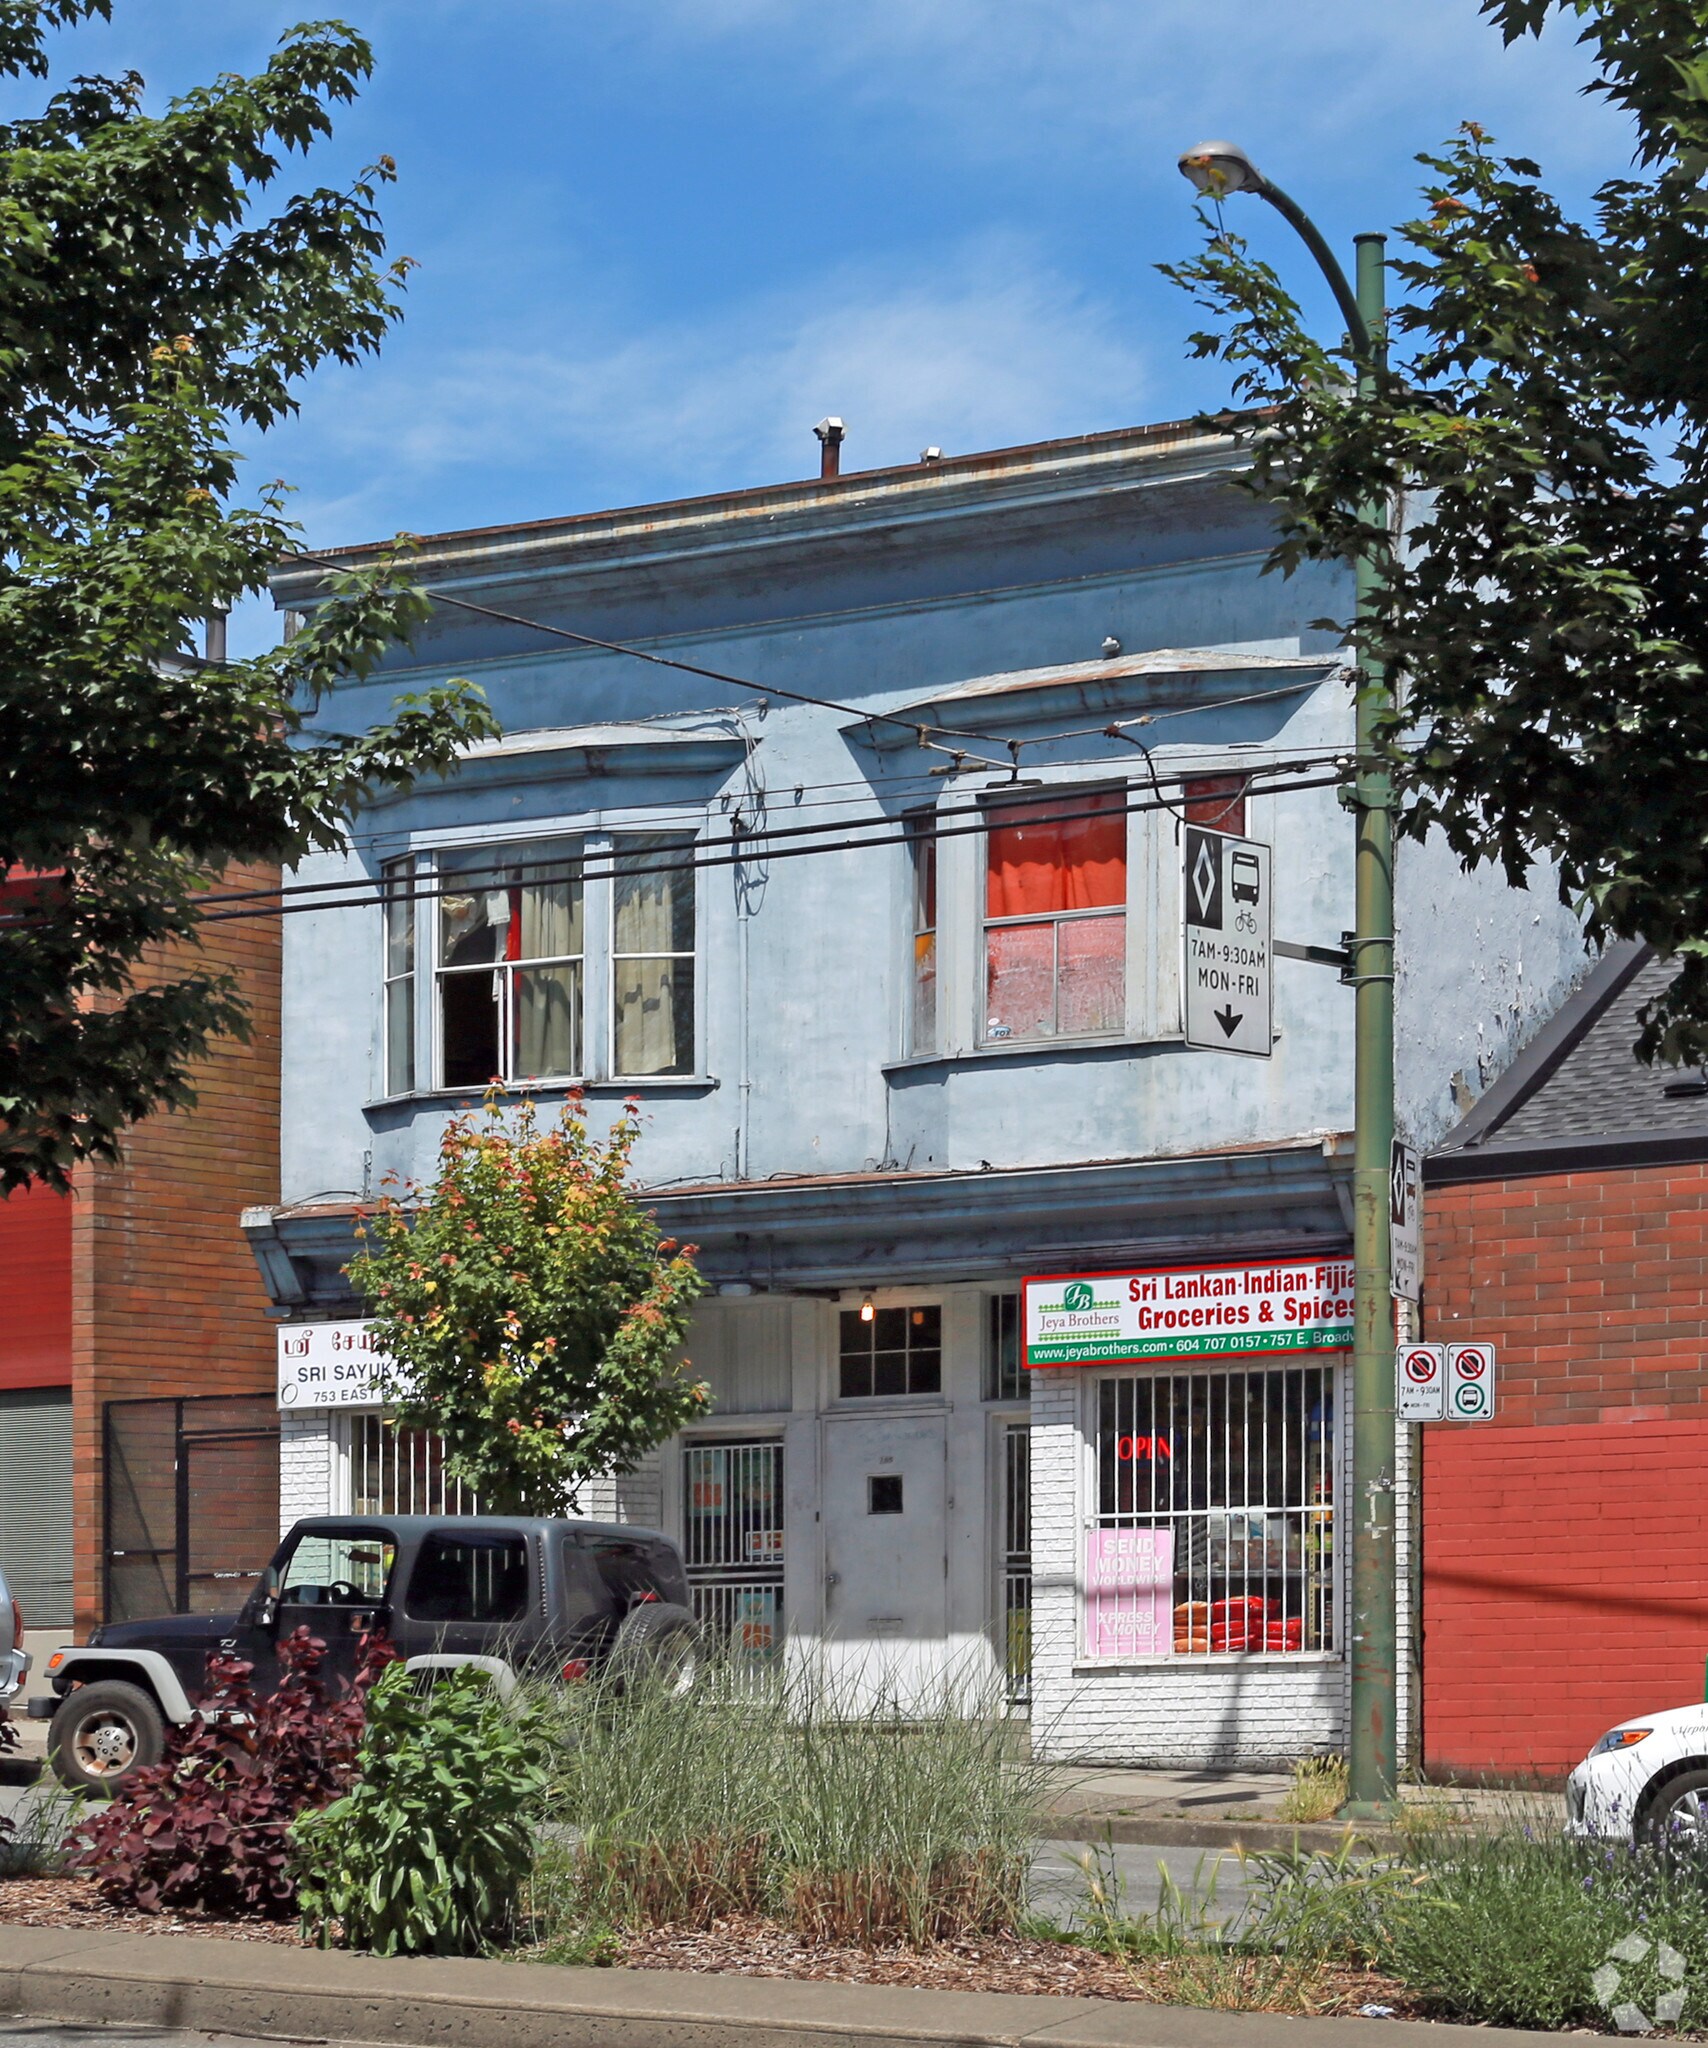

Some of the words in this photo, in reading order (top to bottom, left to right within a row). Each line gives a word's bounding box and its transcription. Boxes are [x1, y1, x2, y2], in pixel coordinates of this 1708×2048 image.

[1191, 939, 1266, 968] 7AM-9:30AM
[1198, 967, 1259, 997] MON-FRI
[1129, 1278, 1157, 1302] Sri
[1315, 1265, 1355, 1295] Fijia
[1040, 1314, 1065, 1332] Jeya
[1068, 1312, 1120, 1327] Brothers
[1138, 1302, 1250, 1330] Groceries
[1258, 1299, 1274, 1323] &
[1034, 1341, 1167, 1361] www.jeyabrothers.com
[1176, 1339, 1200, 1352] 604
[1204, 1337, 1227, 1350] 707
[1230, 1335, 1261, 1349] 0157
[1270, 1333, 1293, 1346] 757
[1297, 1332, 1309, 1345] E.
[298, 1366, 326, 1383] SRI
[314, 1391, 336, 1403] 753
[341, 1387, 376, 1401] EAST
[1103, 1538, 1155, 1554] SEND
[1095, 1556, 1164, 1573] MONEY
[1092, 1574, 1167, 1586] WORLDWIDE
